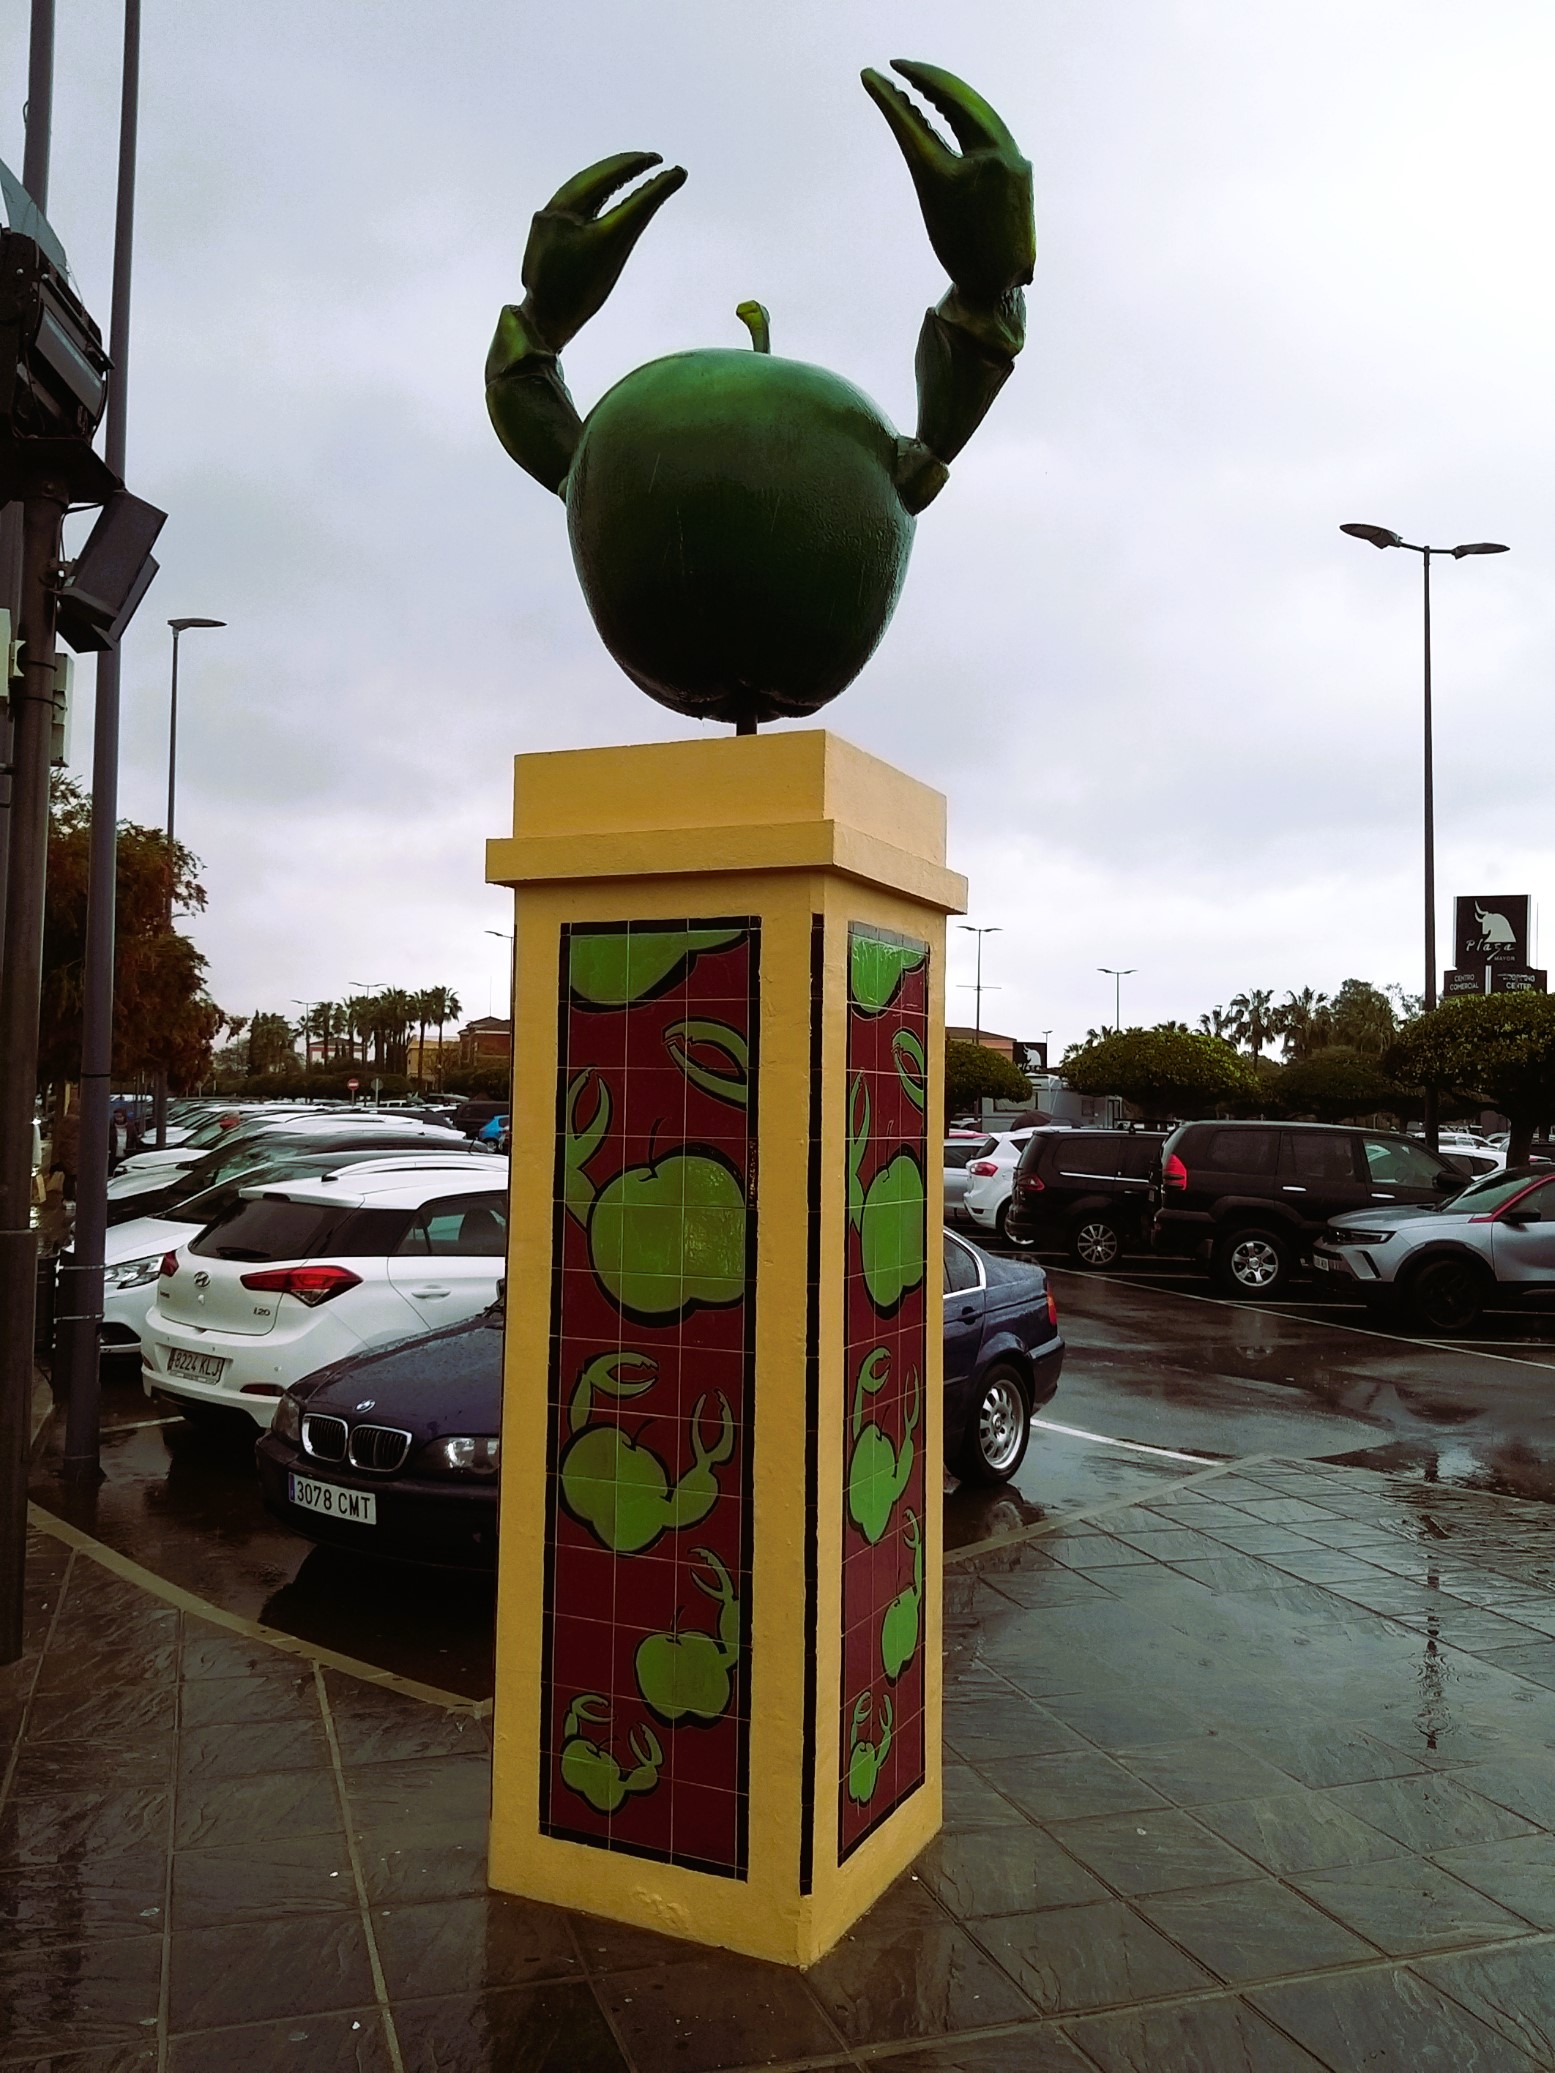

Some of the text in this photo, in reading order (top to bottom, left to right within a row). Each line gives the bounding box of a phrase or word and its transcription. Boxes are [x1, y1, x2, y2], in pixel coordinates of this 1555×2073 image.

[1465, 938, 1515, 961] Plaza
[1449, 982, 1479, 991] COMERCIAL
[1454, 974, 1475, 983] CENTRO
[175, 1352, 220, 1377] 8224 KLJ
[297, 1480, 371, 1520] 3078 CMT
